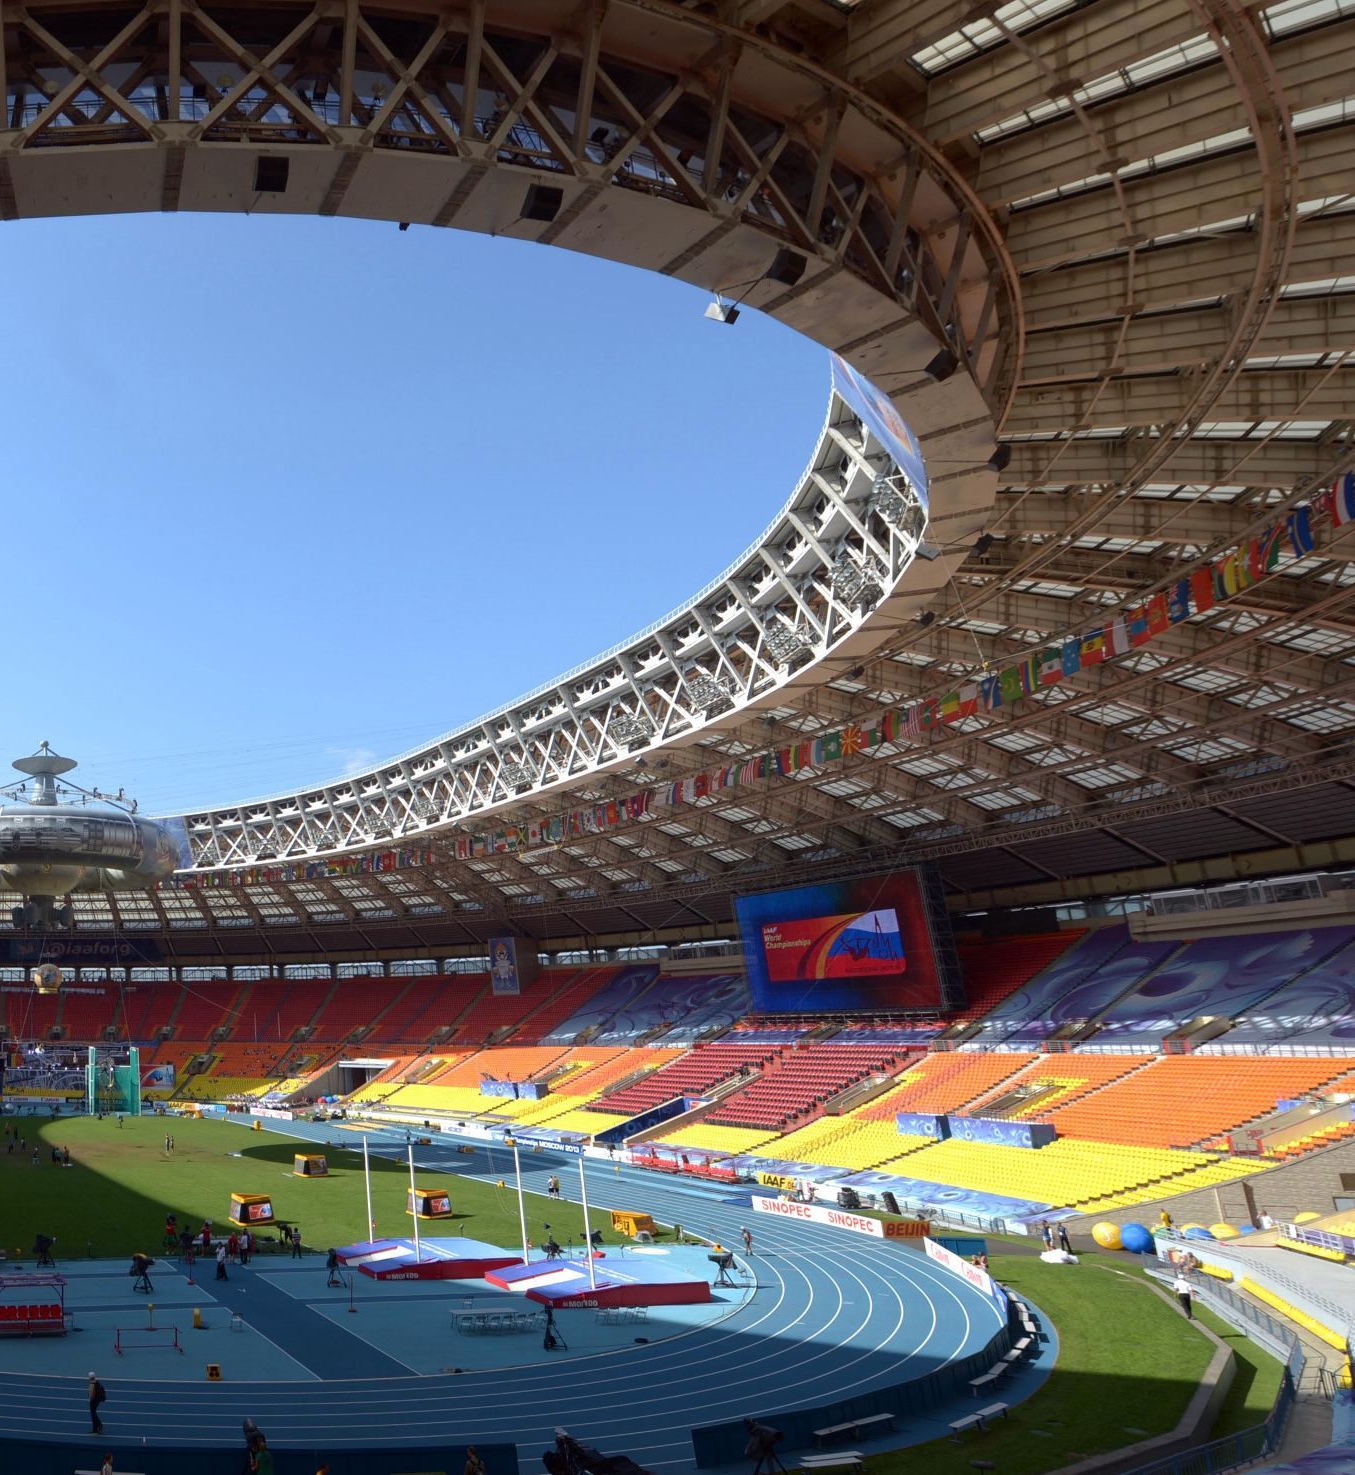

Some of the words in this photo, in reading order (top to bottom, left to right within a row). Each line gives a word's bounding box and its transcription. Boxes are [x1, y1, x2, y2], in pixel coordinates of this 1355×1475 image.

[764, 933, 782, 942] World
[765, 939, 811, 949] Championships
[47, 942, 130, 956] @iaaforg
[538, 1141, 565, 1151] MOSCOW
[565, 1145, 580, 1153] 2013
[763, 1174, 785, 1188] IAAF
[762, 1199, 811, 1218] SINOPEC
[828, 1212, 874, 1232] SINOPEC
